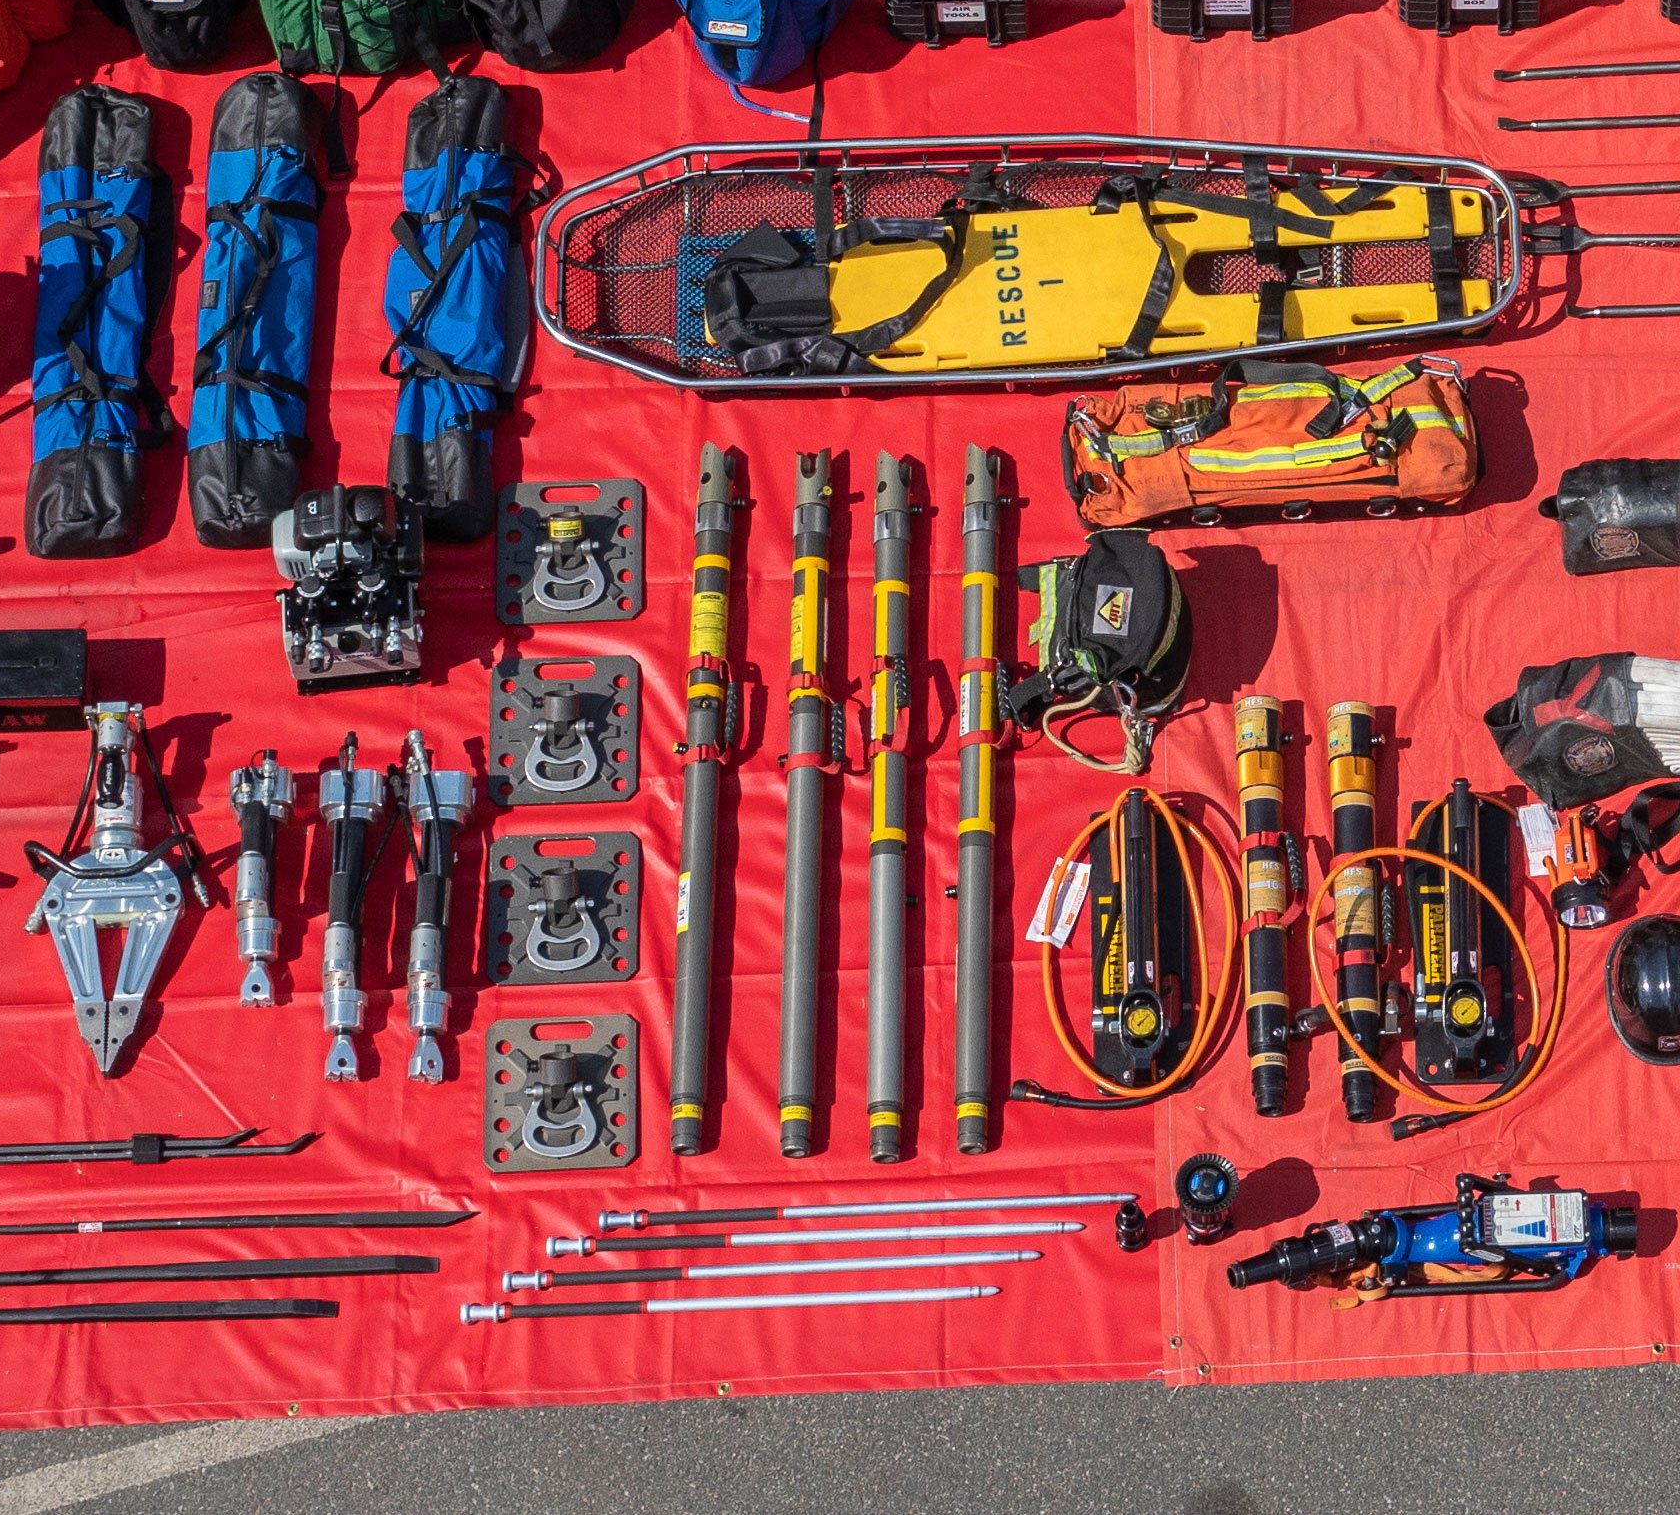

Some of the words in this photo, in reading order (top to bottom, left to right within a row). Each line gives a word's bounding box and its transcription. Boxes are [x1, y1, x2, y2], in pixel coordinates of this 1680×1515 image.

[992, 223, 1028, 348] RESCUE
[1038, 278, 1065, 288] 1
[1108, 602, 1122, 623] RIT
[1244, 697, 1263, 707] HFS
[1333, 703, 1352, 713] HFS
[1262, 861, 1280, 870] HFS
[1343, 868, 1362, 877] HFS
[1430, 904, 1444, 983] PARATECH
[1110, 917, 1124, 994] ARATECH
[1484, 1197, 1494, 1244] BLITZFIRE
